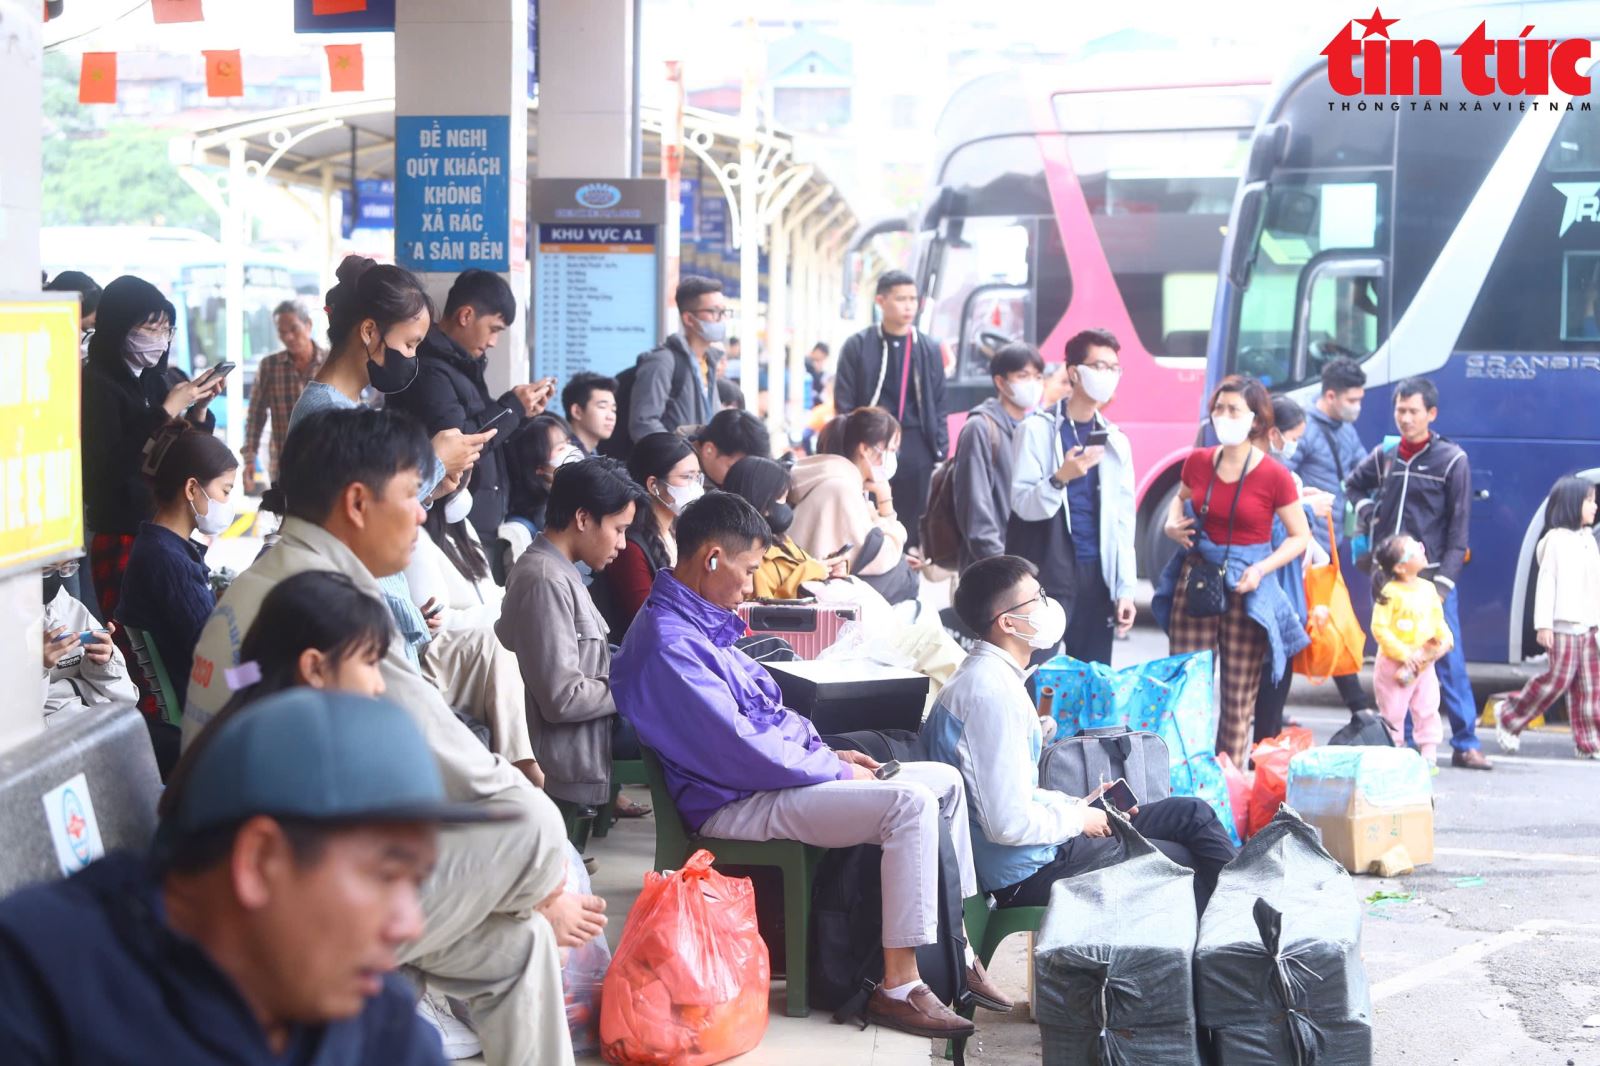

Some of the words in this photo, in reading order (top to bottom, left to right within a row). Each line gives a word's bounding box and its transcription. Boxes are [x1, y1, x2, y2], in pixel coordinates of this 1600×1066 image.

[419, 120, 442, 148] ĐỀ
[447, 129, 487, 151] NGHỊ
[444, 152, 501, 177] KHÁCH
[424, 181, 482, 205] KHÔNG
[421, 208, 444, 232] XẢ
[449, 209, 484, 232] RÁC
[429, 237, 464, 260] SÂN
[469, 232, 503, 260] BẾN
[551, 228, 584, 240] KHU
[587, 227, 620, 243] VỰC
[623, 229, 643, 240] A1
